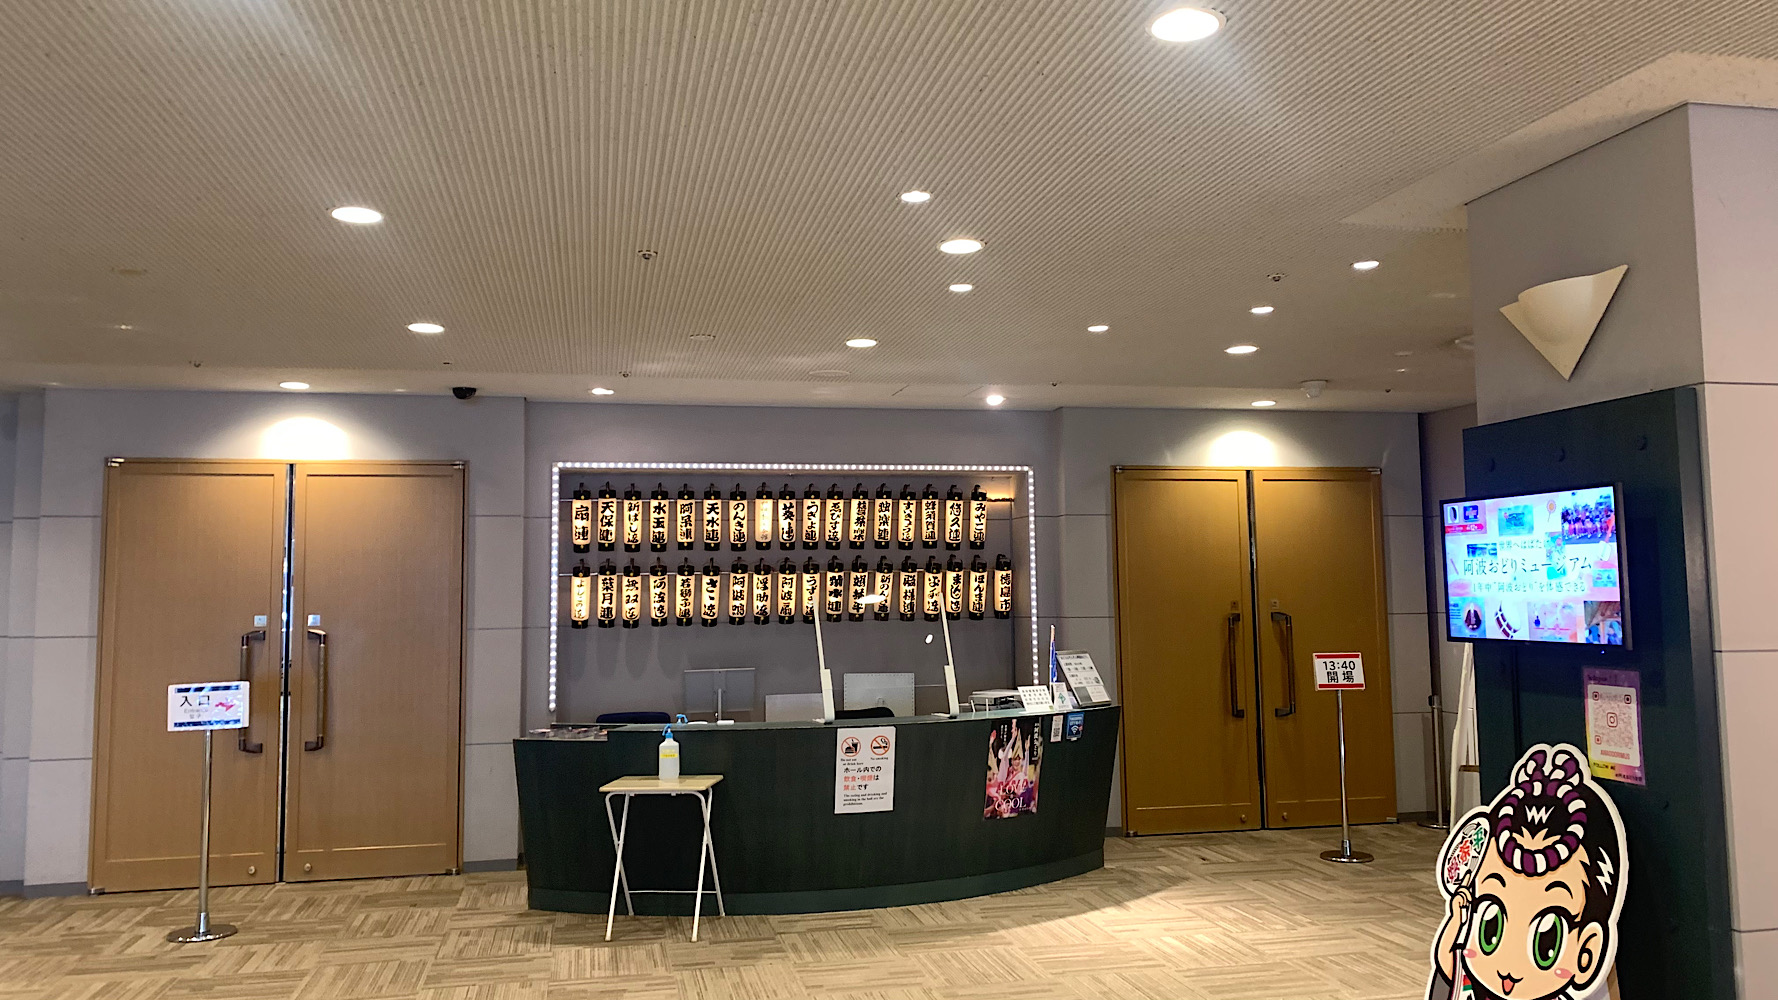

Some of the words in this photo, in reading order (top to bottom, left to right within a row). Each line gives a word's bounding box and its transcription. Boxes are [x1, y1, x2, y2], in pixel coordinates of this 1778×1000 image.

[652, 502, 666, 543] 水玉連
[706, 502, 720, 542] 天水連
[733, 502, 746, 543] のんき連
[1463, 555, 1592, 576] 阿波おどりミュージアム
[1323, 661, 1356, 670] 13:40
[1327, 671, 1354, 683] 開場
[180, 695, 210, 707] 入口
[995, 797, 1027, 810] COOL
